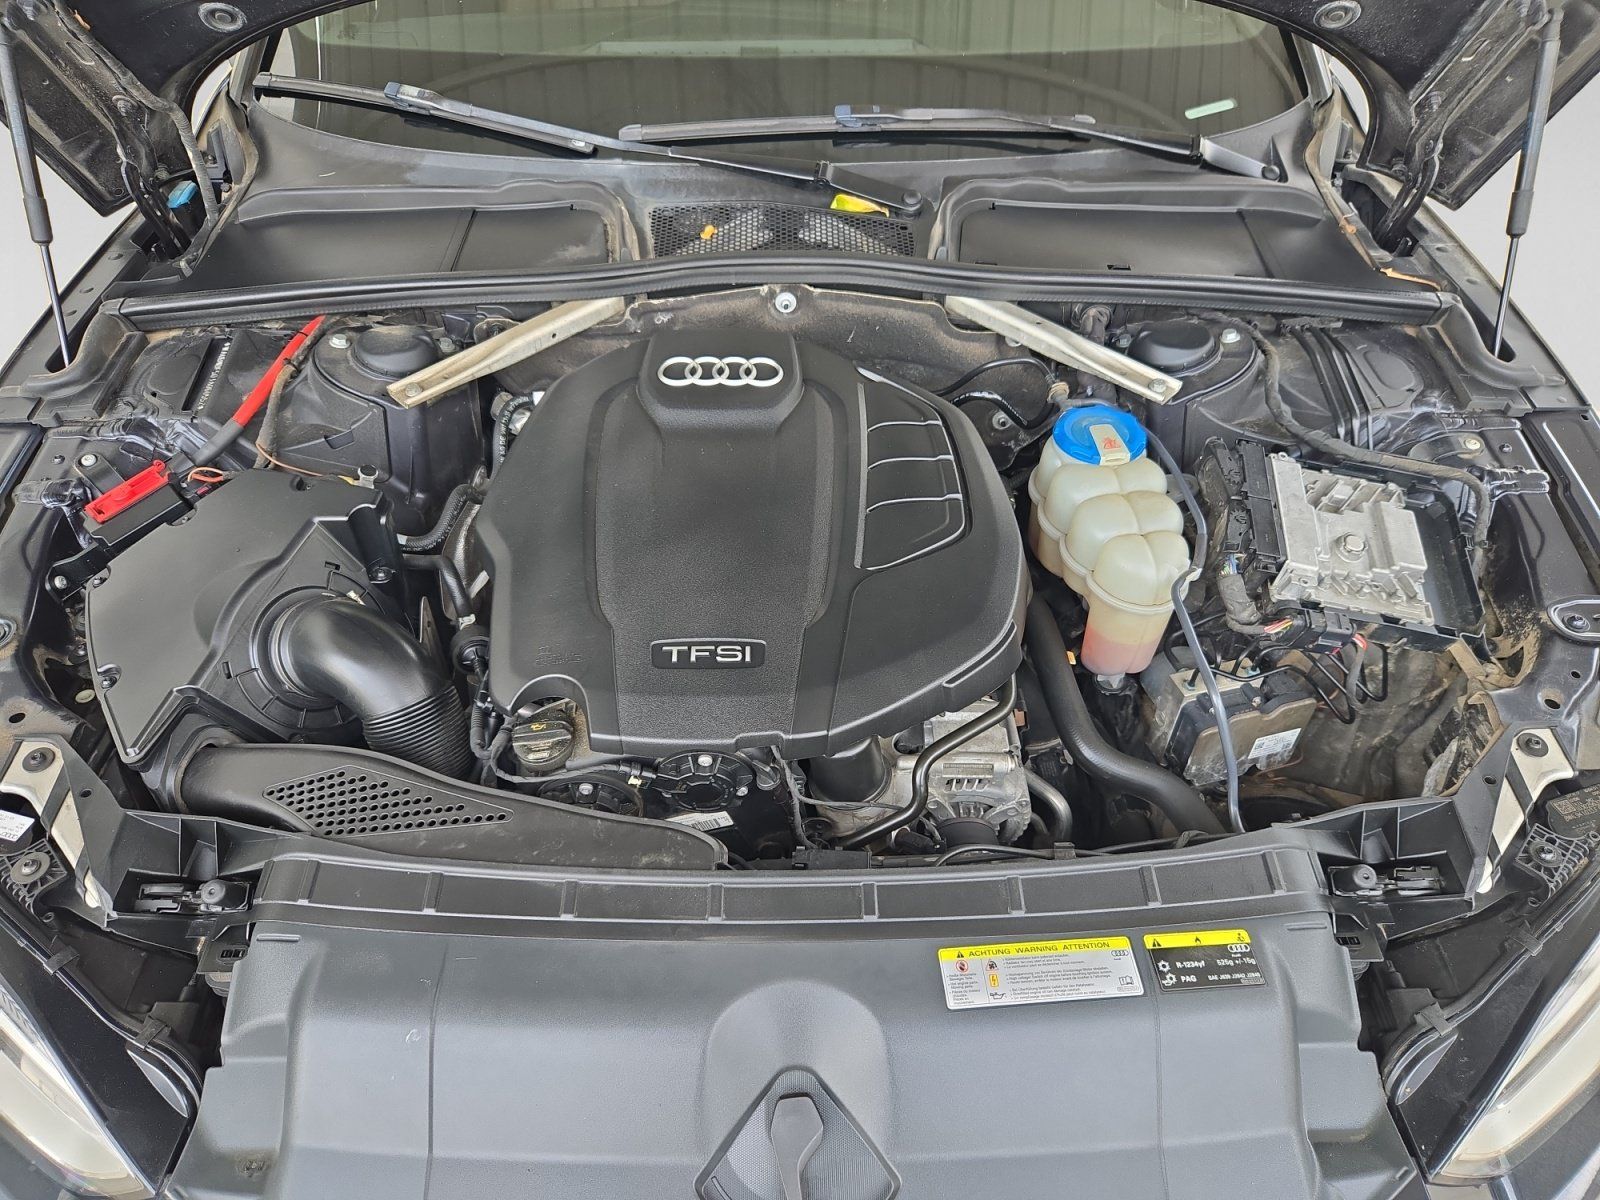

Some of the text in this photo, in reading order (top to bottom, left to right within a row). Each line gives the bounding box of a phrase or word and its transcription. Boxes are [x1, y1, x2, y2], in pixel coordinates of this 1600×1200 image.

[662, 646, 751, 663] TFSI
[969, 942, 1110, 957] ACHTUNG WARNING ATTENTION
[1176, 960, 1205, 968] R-1234yf
